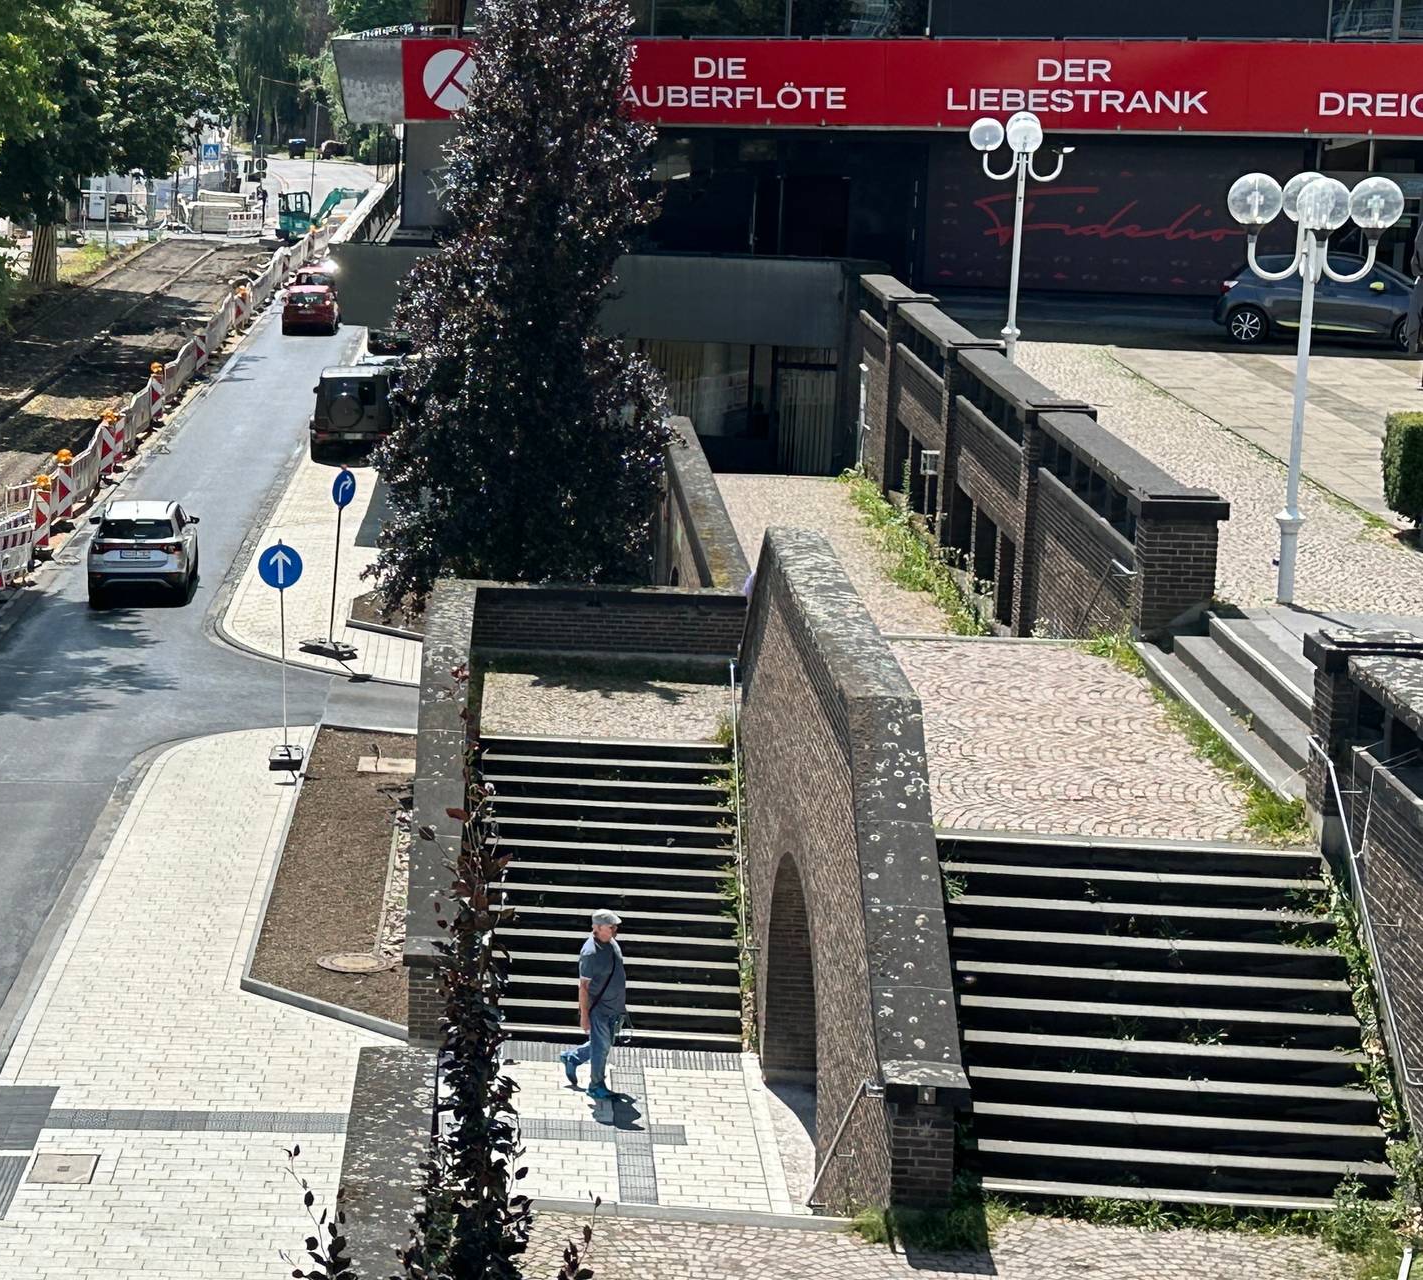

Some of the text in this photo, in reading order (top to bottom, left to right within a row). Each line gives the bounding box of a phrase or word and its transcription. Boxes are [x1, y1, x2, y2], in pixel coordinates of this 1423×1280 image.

[694, 57, 747, 80] DIE
[1037, 59, 1112, 82] DER
[620, 81, 847, 110] AUBERFLÖTE
[947, 88, 1209, 114] LIEBESTRANK
[973, 186, 1246, 247] Fidelio
